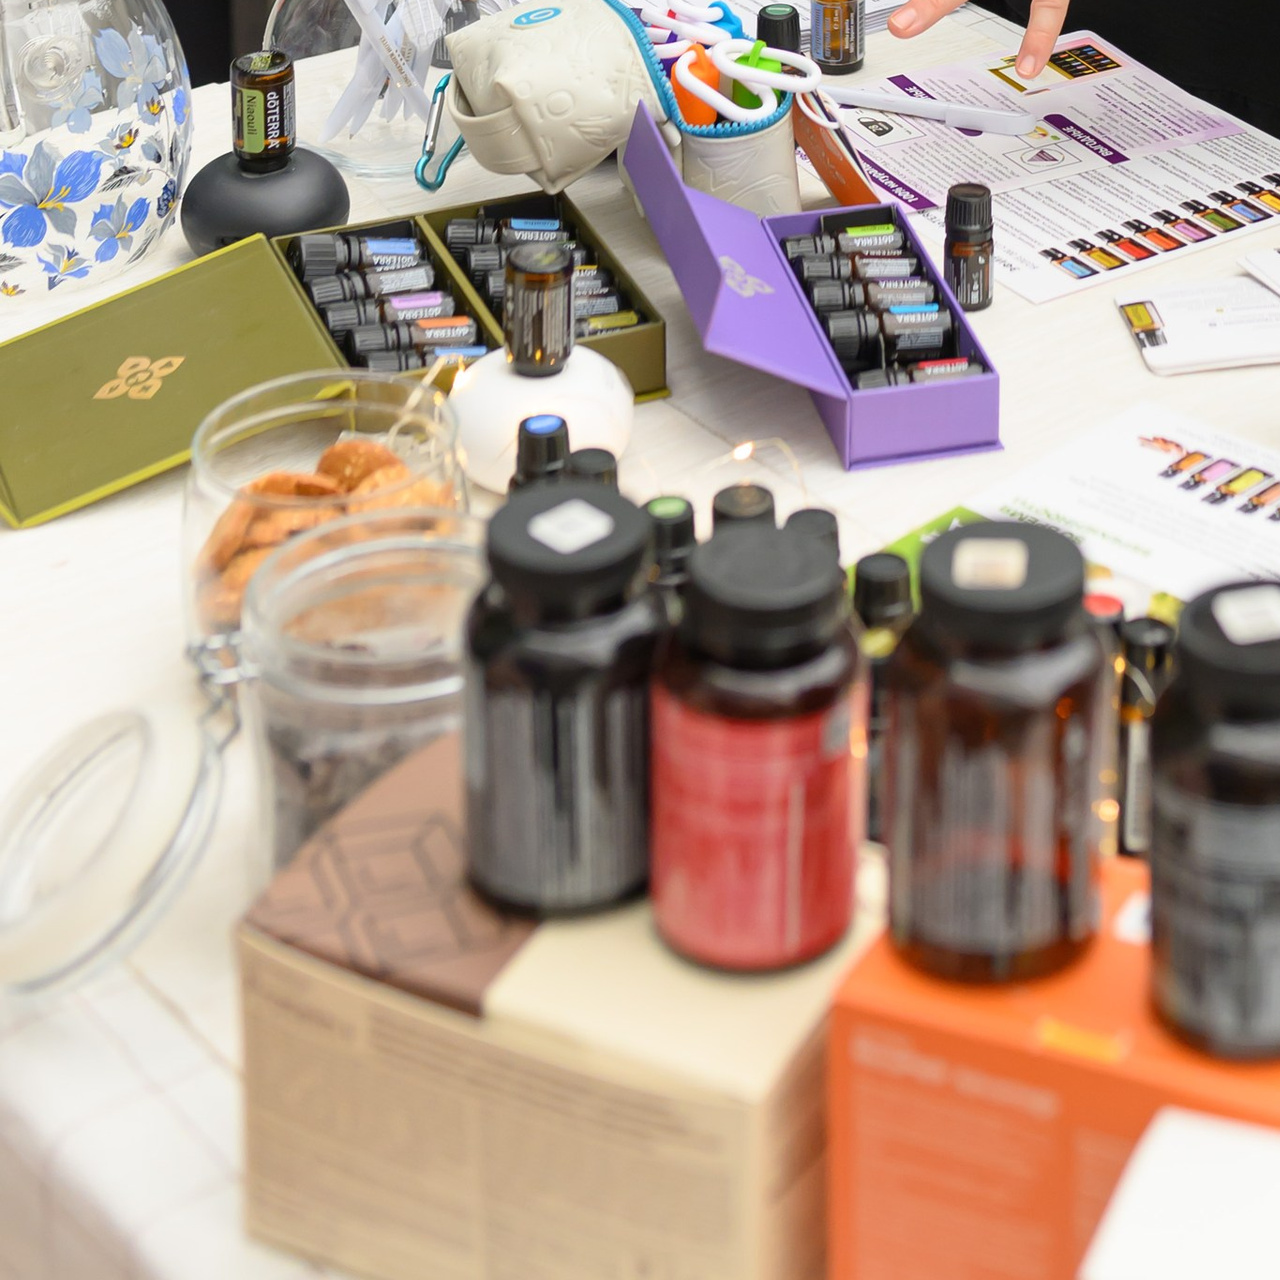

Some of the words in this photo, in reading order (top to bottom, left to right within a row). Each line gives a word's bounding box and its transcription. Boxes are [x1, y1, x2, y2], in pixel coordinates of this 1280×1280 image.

[247, 95, 257, 135] Niaouli
[1062, 125, 1113, 157] ВЫГОДНЫЕ
[893, 187, 916, 203] 100%
